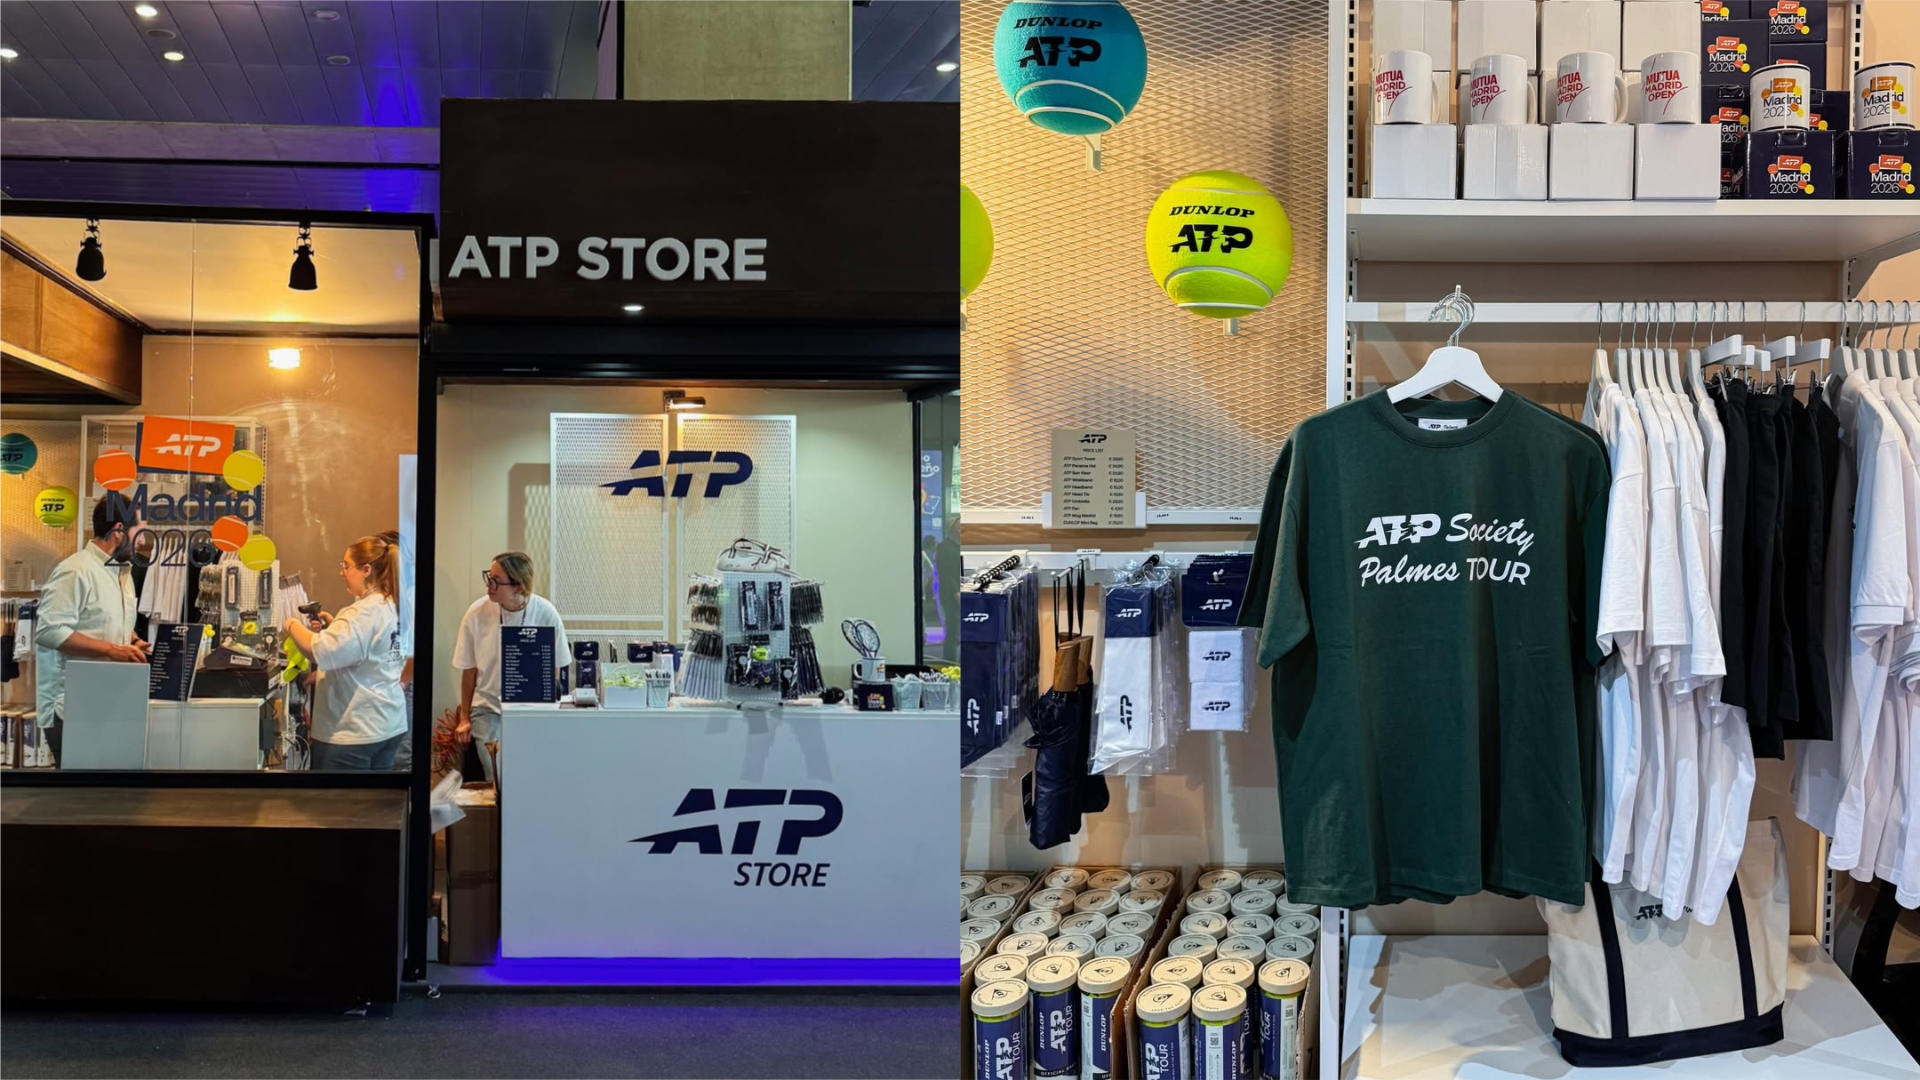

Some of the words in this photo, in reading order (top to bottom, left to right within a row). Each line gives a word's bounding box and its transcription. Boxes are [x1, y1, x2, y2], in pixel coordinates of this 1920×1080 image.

[1014, 16, 1103, 29] DUNLOP
[1771, 15, 1806, 24] Madrid
[1771, 25, 1797, 35] 2026
[1016, 36, 1102, 68] ATP
[1709, 51, 1747, 62] Madrid
[1709, 62, 1735, 73] 2026
[1646, 69, 1680, 85] MUTUA
[1645, 81, 1683, 95] MADRID
[1471, 95, 1494, 108] OPEN
[1648, 90, 1677, 103] OPEN
[1763, 94, 1803, 107] Madrid
[1722, 123, 1748, 132] adrid
[1782, 158, 1801, 166] ATP
[1884, 157, 1901, 166] ATP
[1769, 172, 1811, 183] Madrid
[1871, 172, 1912, 183] Madrid
[1769, 183, 1799, 194] 2026
[1870, 183, 1900, 194] 2026
[1168, 205, 1255, 219] DUNLOP
[1168, 223, 1254, 255] ATP
[448, 235, 560, 279] ATP
[576, 236, 768, 282] STORE
[152, 433, 222, 457] ATP
[1078, 433, 1108, 444] ATP
[600, 450, 754, 498] ATP
[106, 483, 262, 523] Madrid
[1353, 513, 1442, 550] ATP
[1445, 512, 1535, 557] Society
[104, 528, 217, 568] 2026
[1358, 554, 1461, 588] Palmes
[1466, 557, 1532, 586] TOUR
[1199, 598, 1234, 611] ATP
[962, 611, 990, 623] ATP
[1114, 607, 1142, 619] ATP
[1202, 650, 1232, 662] ATP
[1202, 700, 1232, 713] ATP
[966, 698, 980, 736] ATP
[1119, 694, 1133, 735] ATP
[626, 788, 844, 856] ATP
[733, 861, 831, 888] STORE
[1065, 1004, 1073, 1035] TOUR
[1050, 1010, 1067, 1054] ATP
[1012, 1031, 1021, 1063] TOUR
[996, 1037, 1013, 1080] ATP
[1159, 1043, 1169, 1073] TOUR
